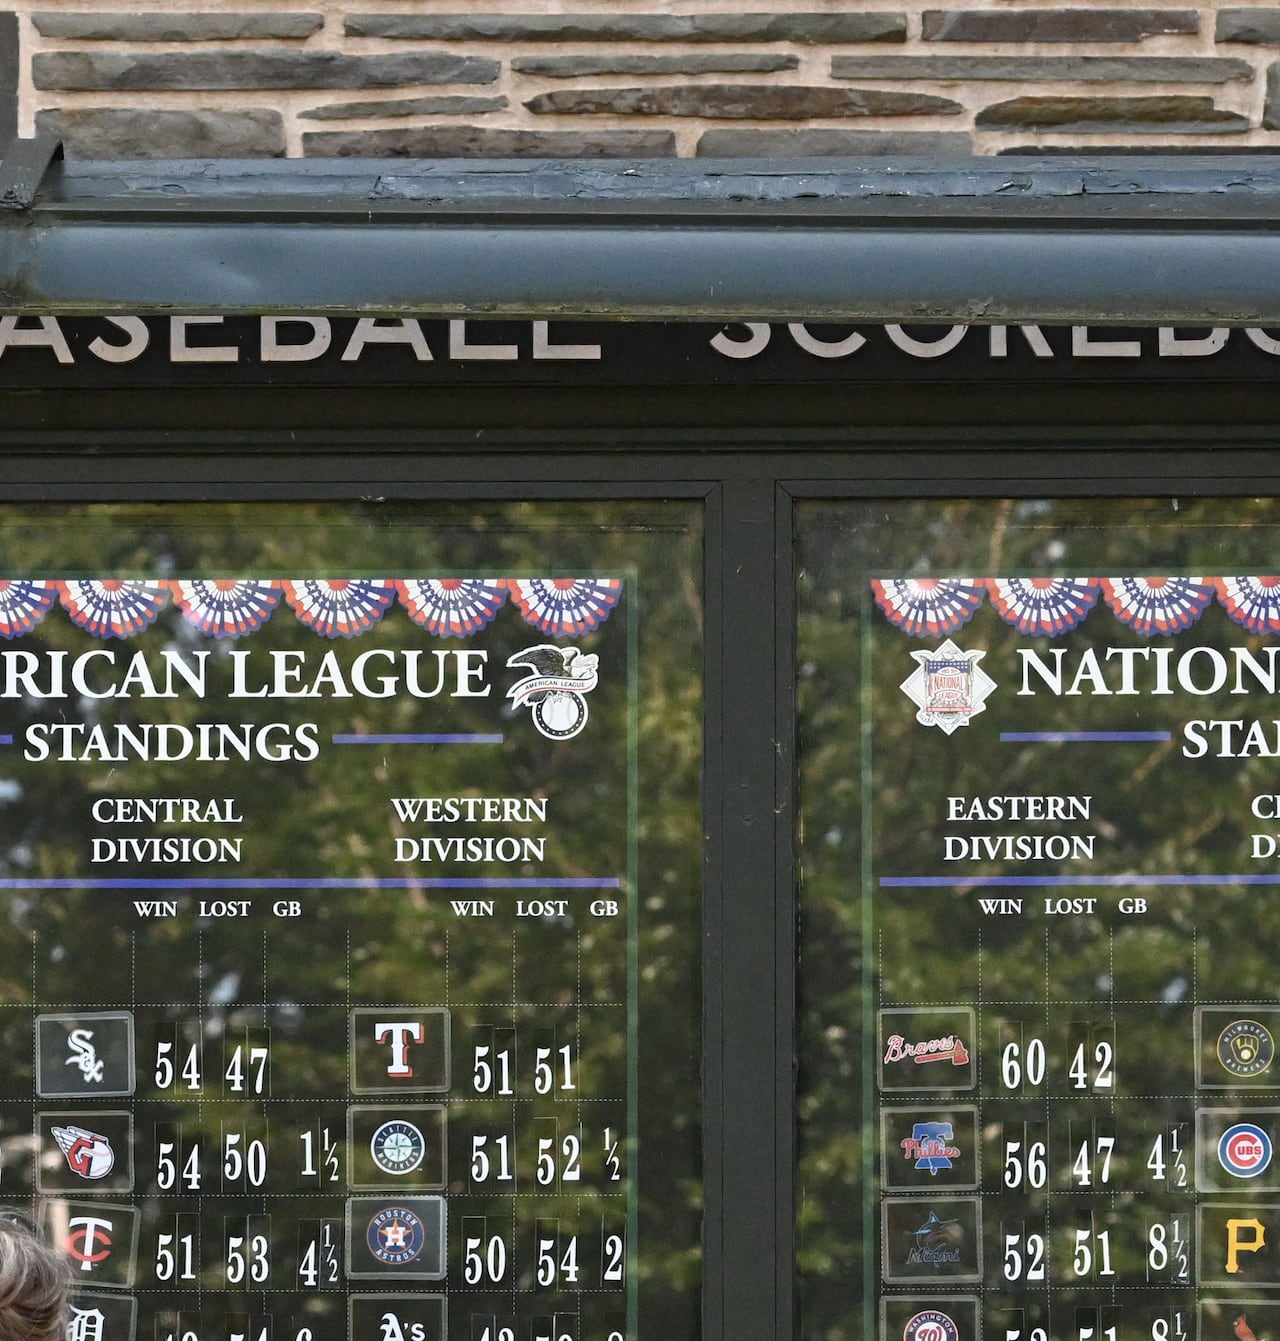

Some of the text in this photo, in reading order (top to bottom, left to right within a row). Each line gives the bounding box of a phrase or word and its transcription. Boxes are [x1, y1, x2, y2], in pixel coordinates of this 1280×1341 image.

[227, 649, 492, 698] LEAGUE
[23, 723, 320, 762] STANDINGS
[92, 798, 244, 823] CENTRAL
[390, 797, 549, 823] WESTERN
[946, 796, 1092, 821] EASTERN
[91, 838, 243, 863] DIVISION
[394, 837, 547, 862] DIVISION
[943, 835, 1096, 861] DIVISION
[133, 900, 302, 917] WIN LOST GB
[450, 900, 619, 917] WIN LOST GB
[978, 897, 1147, 915] WIN LOST GB
[884, 1034, 953, 1064] Braves
[155, 1042, 268, 1094] 54 47
[473, 1044, 576, 1095] 51 51
[1002, 1038, 1113, 1089] 60 42
[157, 1143, 201, 1190] 54
[224, 1133, 266, 1187] 50
[471, 1135, 513, 1182] 51
[537, 1134, 580, 1185] 52
[901, 1138, 960, 1160] Phillies
[1004, 1141, 1047, 1189] 56
[1072, 1137, 1115, 1186] 47
[374, 1209, 418, 1226] HOUSTON
[156, 1234, 196, 1281] 51
[227, 1235, 269, 1283] 53
[375, 1248, 416, 1262] ASTROS
[464, 1235, 623, 1286] 50 54 2
[1004, 1234, 1045, 1281] 52
[1073, 1229, 1115, 1276] 51
[908, 1314, 954, 1333] WASHINGTON
